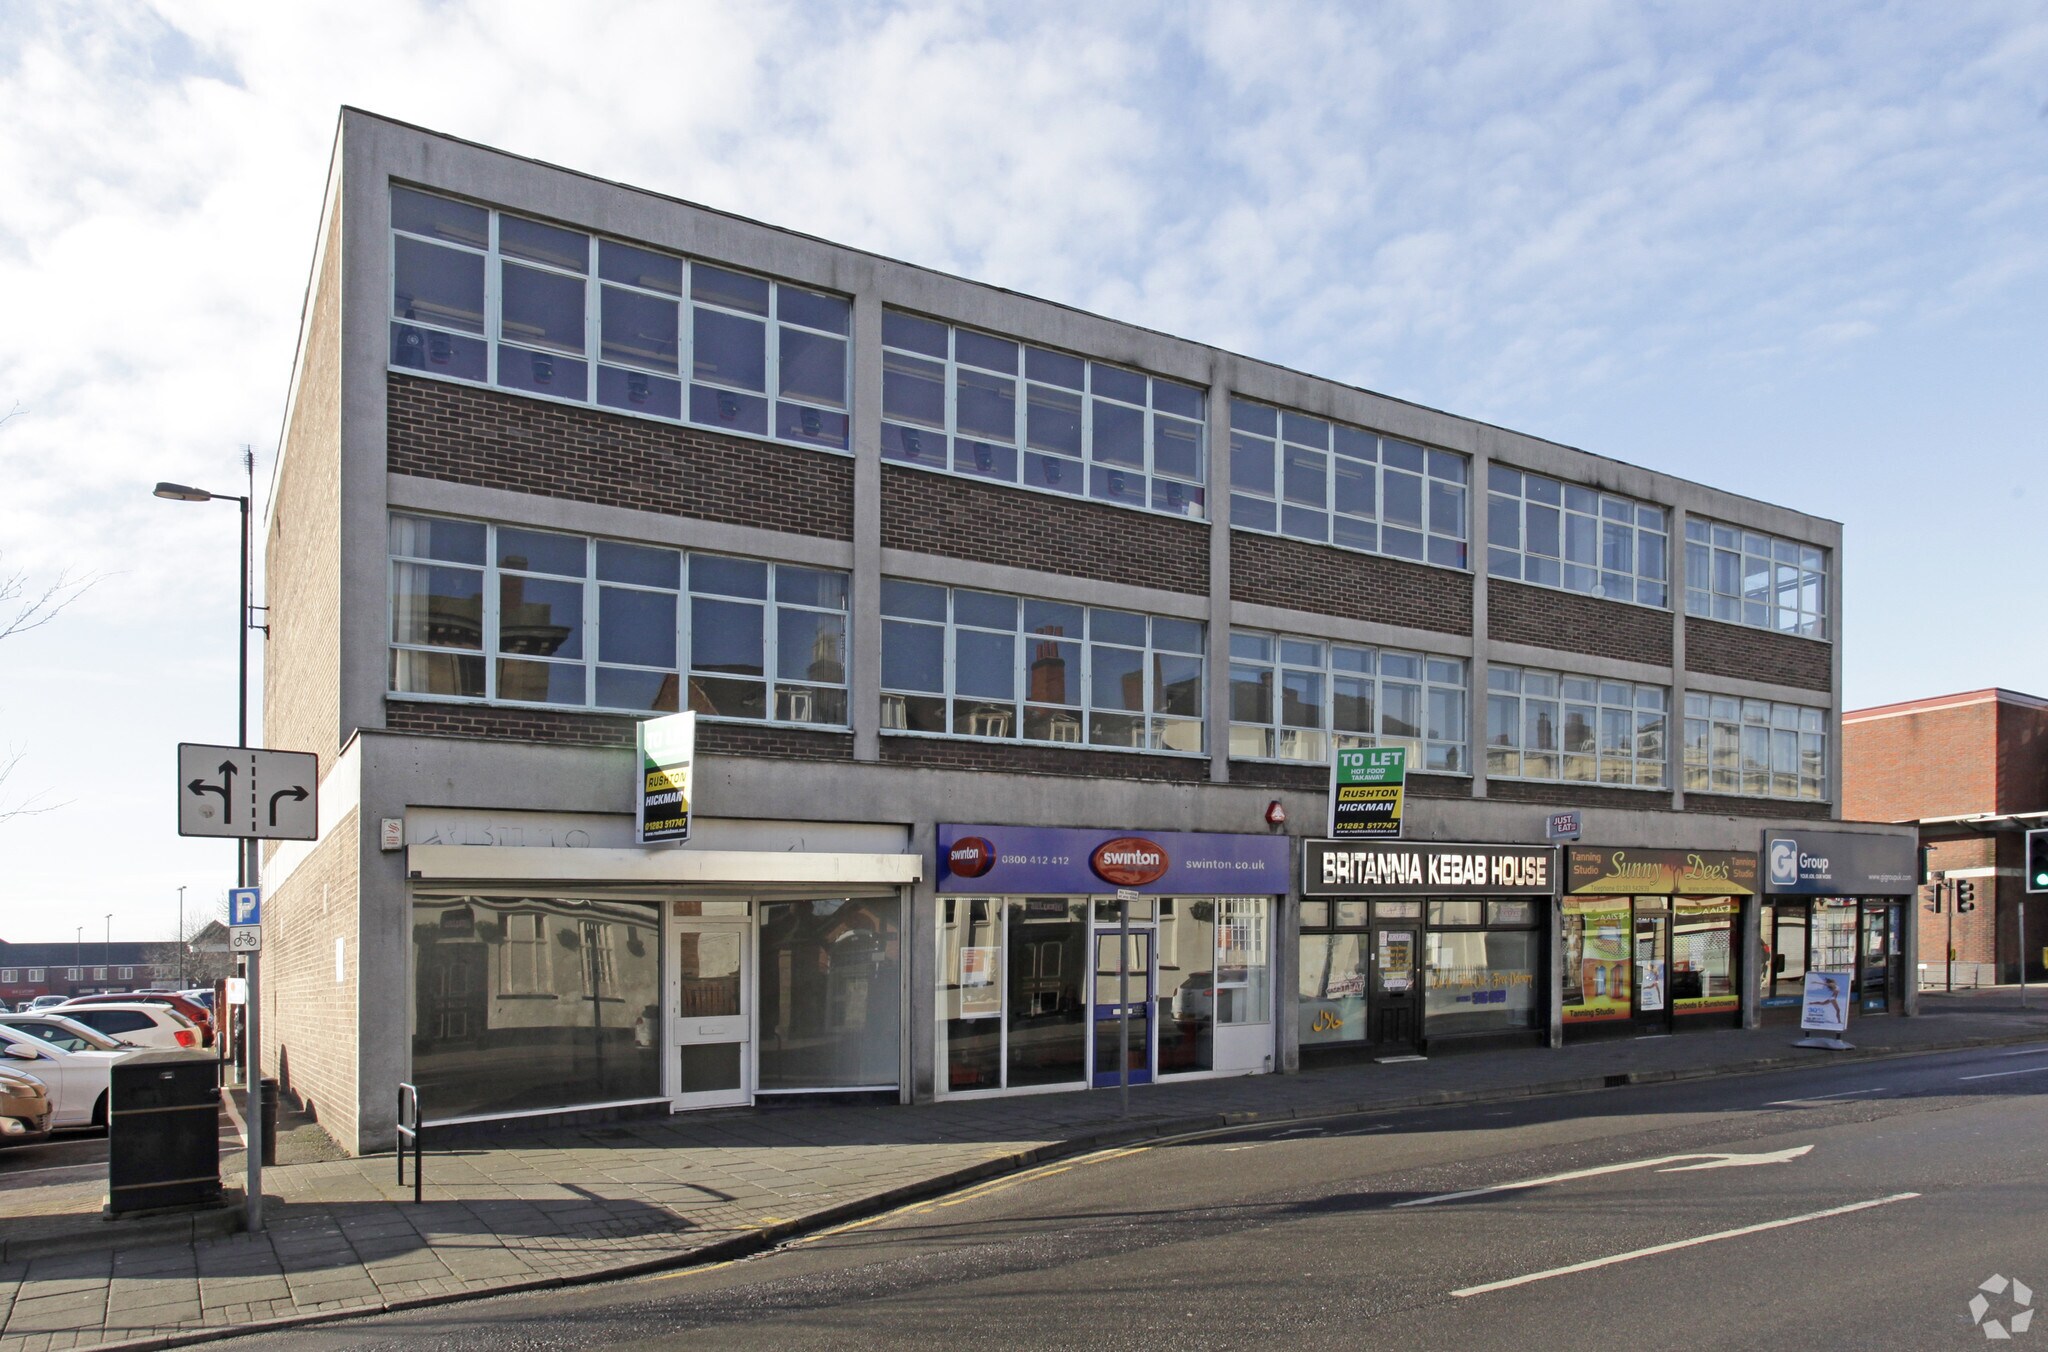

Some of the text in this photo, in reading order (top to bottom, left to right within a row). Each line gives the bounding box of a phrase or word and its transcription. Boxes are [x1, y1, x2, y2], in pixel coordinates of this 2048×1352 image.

[1341, 752, 1403, 767] TO LET
[648, 772, 687, 788] RUSHTON
[645, 790, 684, 807] HICKMAN
[1342, 789, 1399, 798] RUSHTON
[1337, 802, 1394, 812] HICKMAN
[645, 818, 686, 831] 01283 517747
[1336, 822, 1364, 830] 01283
[1553, 815, 1572, 825] JUST
[1557, 823, 1571, 832] EAT
[951, 846, 979, 860] swinton
[1103, 849, 1160, 865] swinton
[1571, 852, 1602, 864] Tanning
[1002, 855, 1069, 865] 0800 412 412
[1186, 858, 1265, 870] swinton.co.uk
[1731, 857, 1756, 868] Tanning
[1771, 844, 1829, 878] Gi Group
[1323, 852, 1547, 886] BRITANNIA KEBAB HOUSE
[1573, 865, 1599, 875] Studio
[1606, 851, 1729, 885] Sunny Dee's
[1733, 869, 1754, 878] Studio
[1591, 885, 1615, 893] Telephone
[236, 892, 256, 923] P
[1673, 1002, 1697, 1010] Sunbeds
[1704, 1000, 1736, 1008] Sunshowers
[1569, 1007, 1616, 1018] Tanning Studio
[1313, 1009, 1344, 1032] حلال
